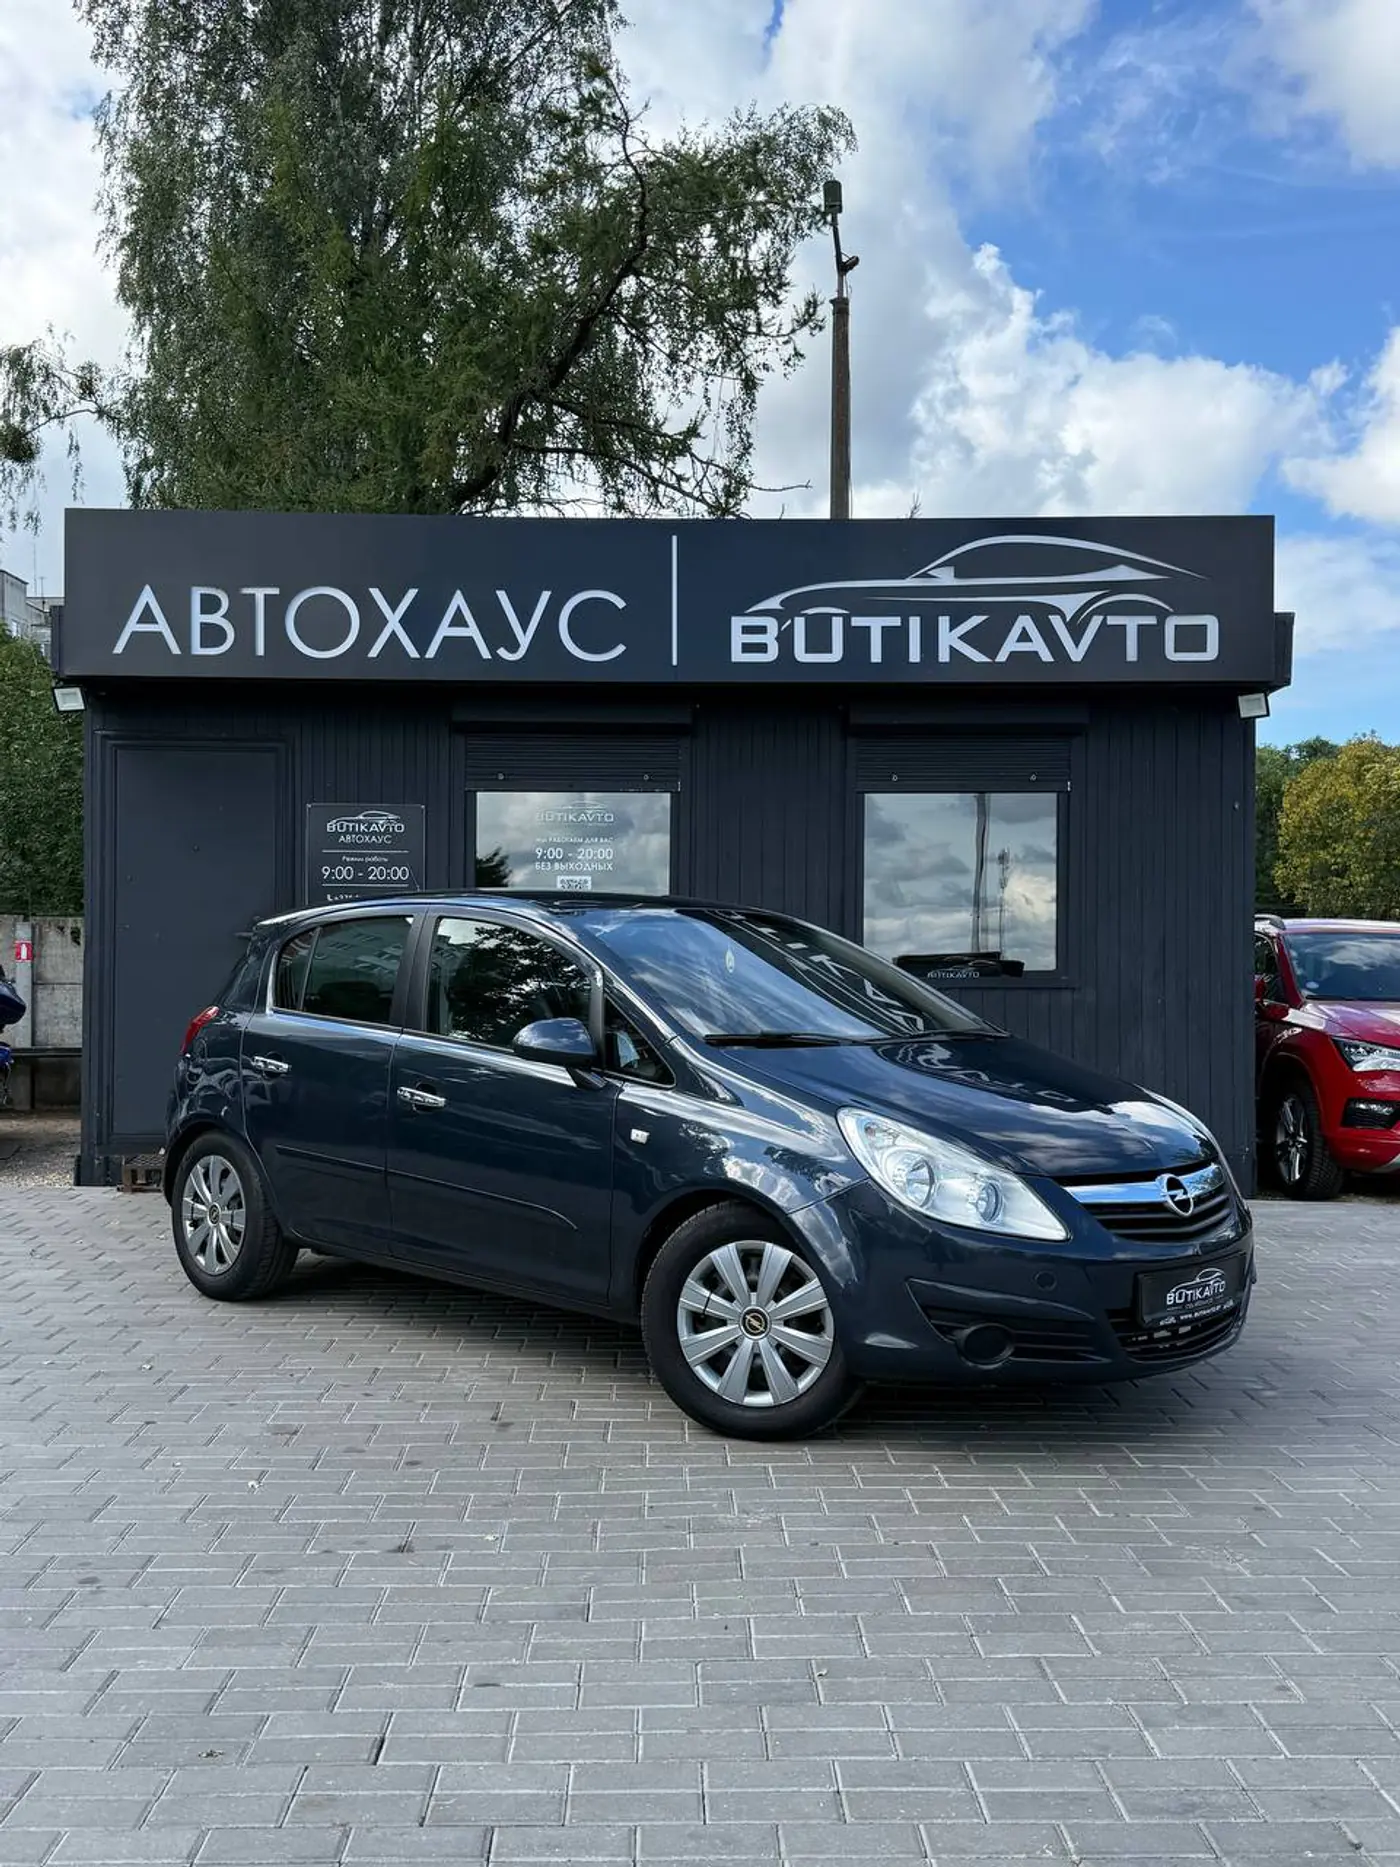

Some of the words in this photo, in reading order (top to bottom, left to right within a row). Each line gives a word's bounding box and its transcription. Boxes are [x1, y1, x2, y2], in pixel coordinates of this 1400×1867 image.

[111, 583, 629, 662] АВТОХАУС
[729, 613, 1220, 663] BUTIKAVTO
[326, 822, 405, 833] BUTIKAVTO
[338, 834, 393, 844] АВТОХАУС
[535, 847, 564, 860] 9:00
[577, 847, 614, 860] 20:00
[321, 866, 354, 880] 9:00
[367, 866, 410, 880] 20:00
[535, 861, 551, 871] БЕЗ
[553, 861, 613, 872] ВЫХОДНЫХ
[1166, 1280, 1226, 1306] BUTIKAVTO
